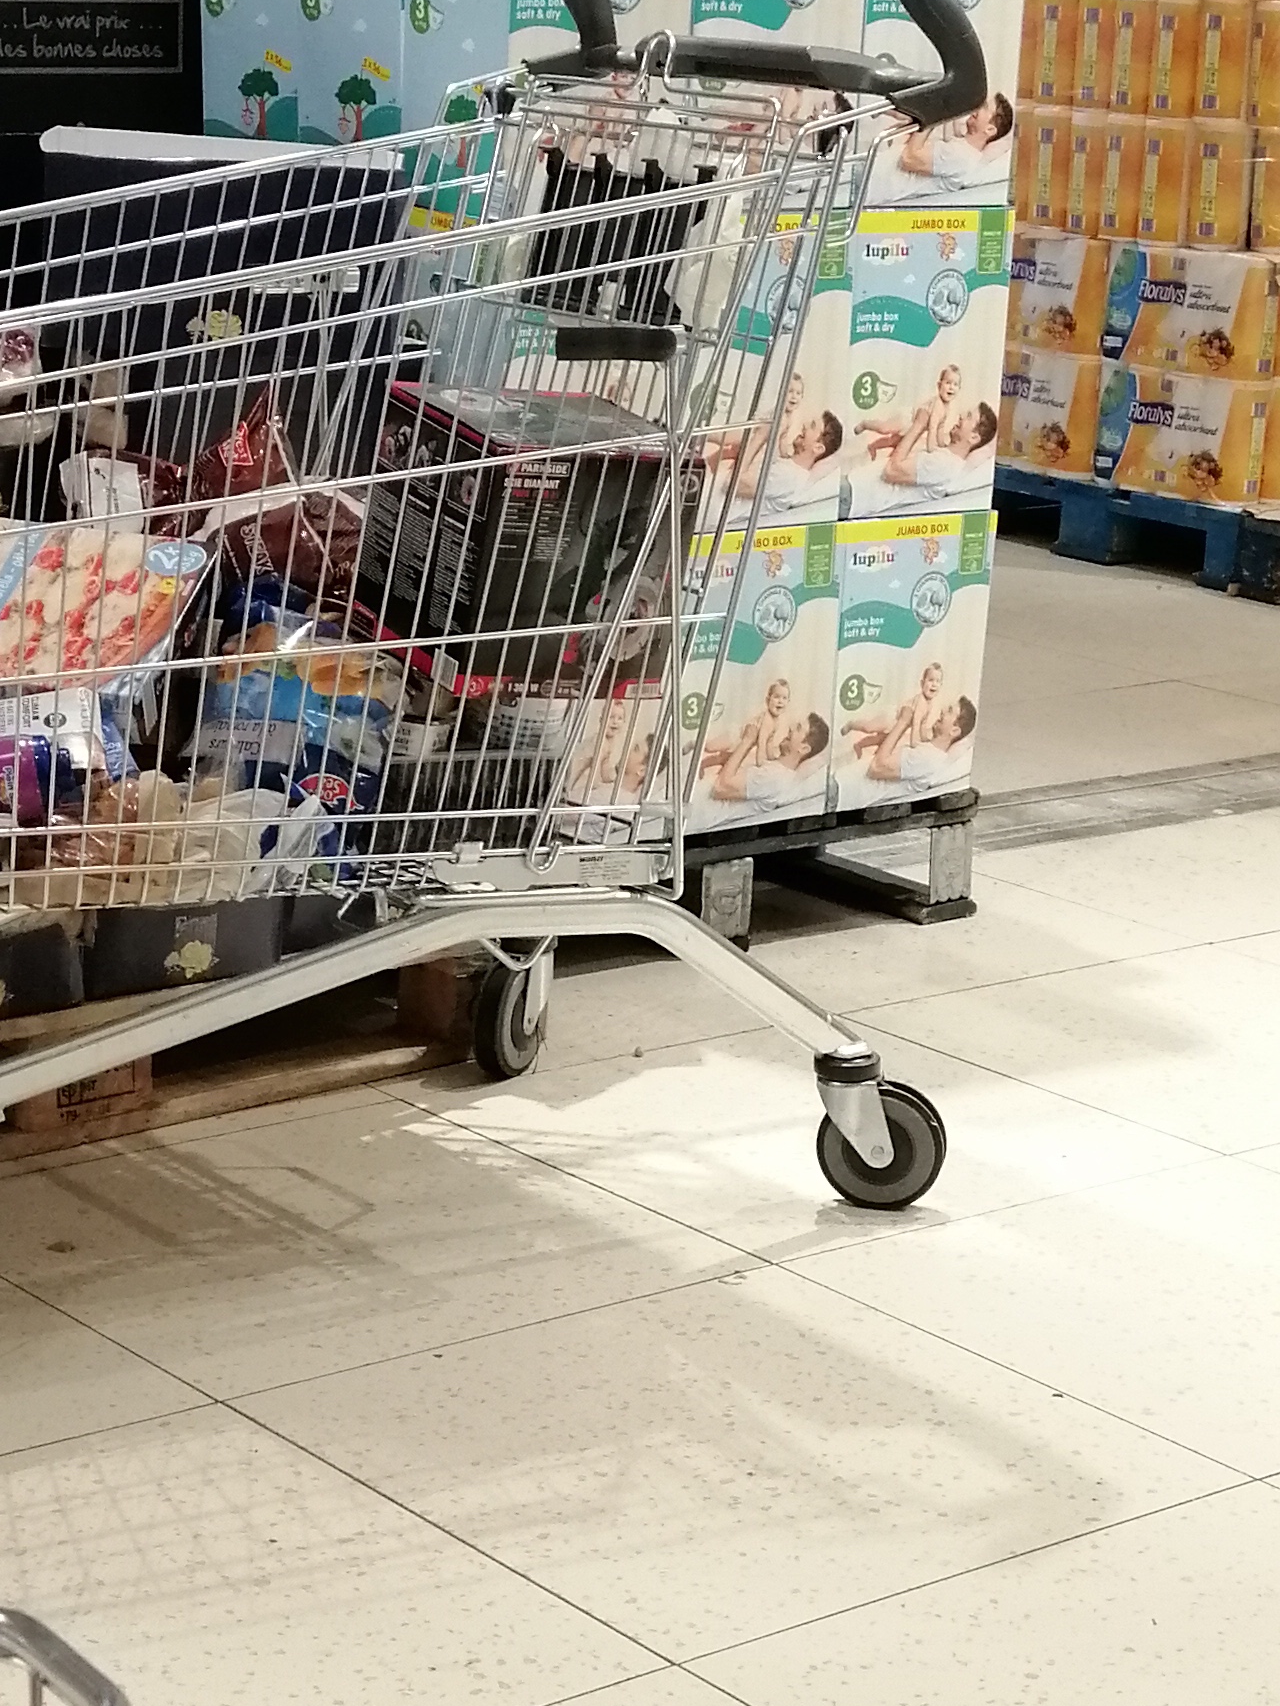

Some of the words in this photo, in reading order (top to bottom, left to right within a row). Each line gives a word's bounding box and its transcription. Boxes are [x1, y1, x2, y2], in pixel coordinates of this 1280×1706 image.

[55, 8, 90, 29] vrai
[95, 10, 131, 37] prix
[33, 34, 96, 58] bonnes
[103, 39, 163, 58] choses
[911, 219, 944, 229] JUMBO
[946, 219, 966, 229] BOX
[866, 244, 910, 259] lupilu
[1139, 279, 1185, 303] Floralys
[861, 376, 871, 395] 3
[1128, 401, 1173, 424] Floralys
[521, 463, 568, 474] PARSIDE
[897, 524, 928, 537] JUMBO
[930, 523, 949, 535] BOX
[853, 552, 895, 567] lupilu
